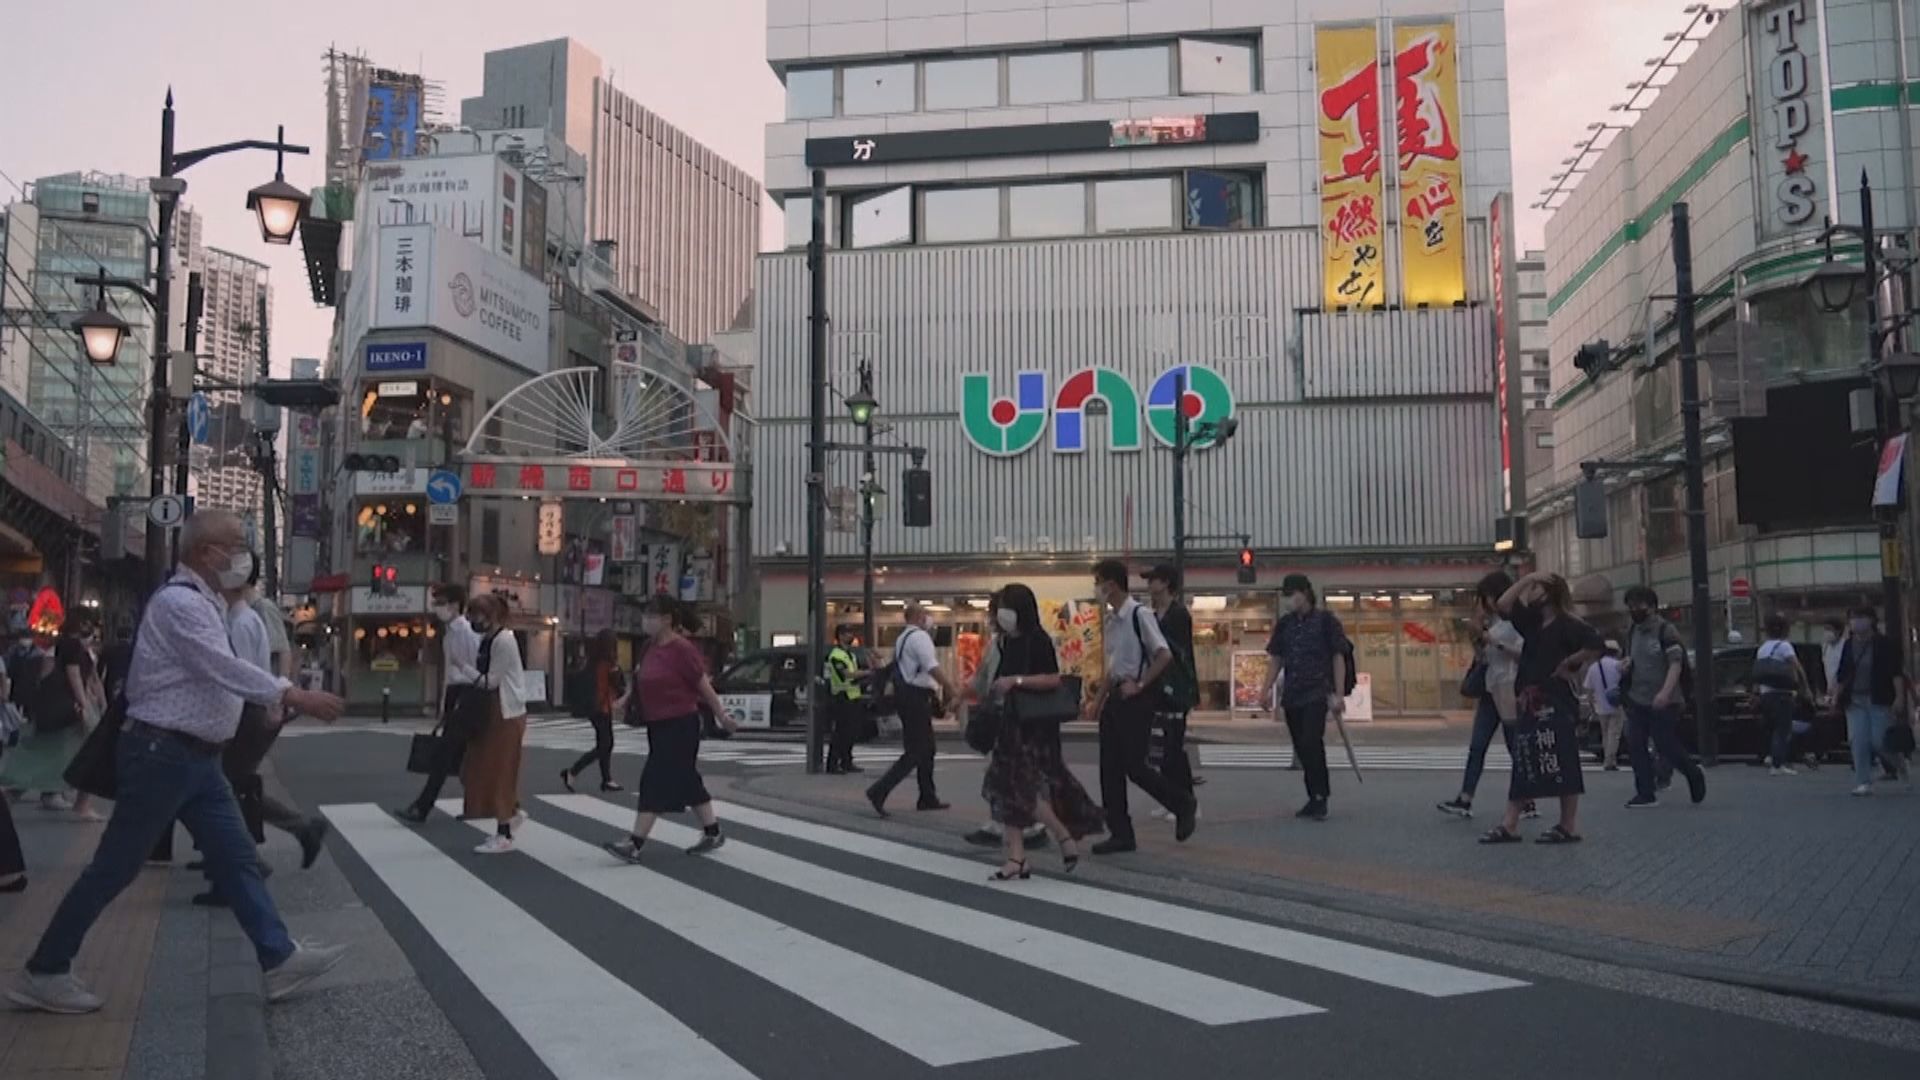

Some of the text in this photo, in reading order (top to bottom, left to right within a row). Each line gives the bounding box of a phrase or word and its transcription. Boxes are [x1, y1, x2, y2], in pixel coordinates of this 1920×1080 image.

[1321, 39, 1459, 184] 夏
[853, 140, 876, 160] 分
[395, 236, 414, 314] 三本珈琲
[479, 307, 523, 342] COFFEE
[480, 286, 541, 330] MITSUMOTO
[960, 364, 1236, 457] uno
[471, 463, 728, 495] 新橋西口通り
[722, 698, 746, 706] TAXI
